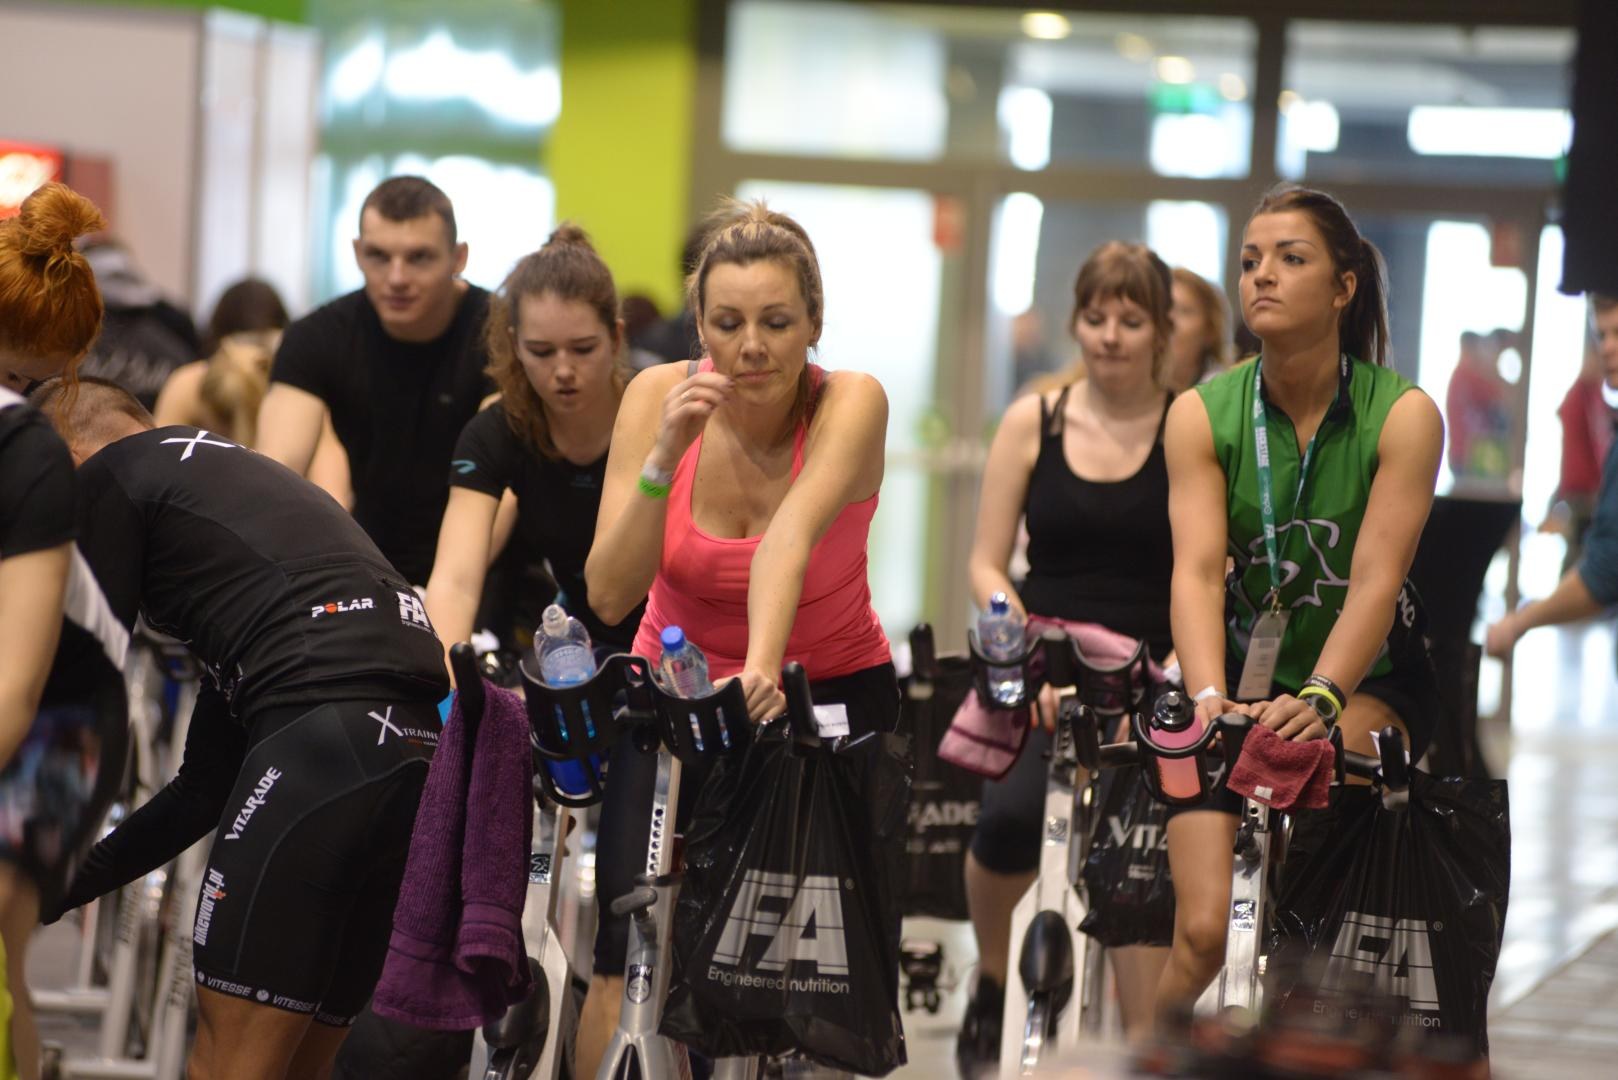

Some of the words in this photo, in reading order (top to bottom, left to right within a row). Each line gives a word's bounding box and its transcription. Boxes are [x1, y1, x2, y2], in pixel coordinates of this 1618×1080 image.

[311, 598, 375, 618] POLAR
[396, 591, 430, 628] FA
[224, 766, 282, 841] VITARADE
[711, 868, 849, 976] FA
[707, 965, 786, 992] Engineered
[789, 976, 850, 994] nutrition
[1318, 911, 1441, 1011] FA
[207, 976, 252, 997] VITESSE
[273, 994, 315, 1012] VITESSE
